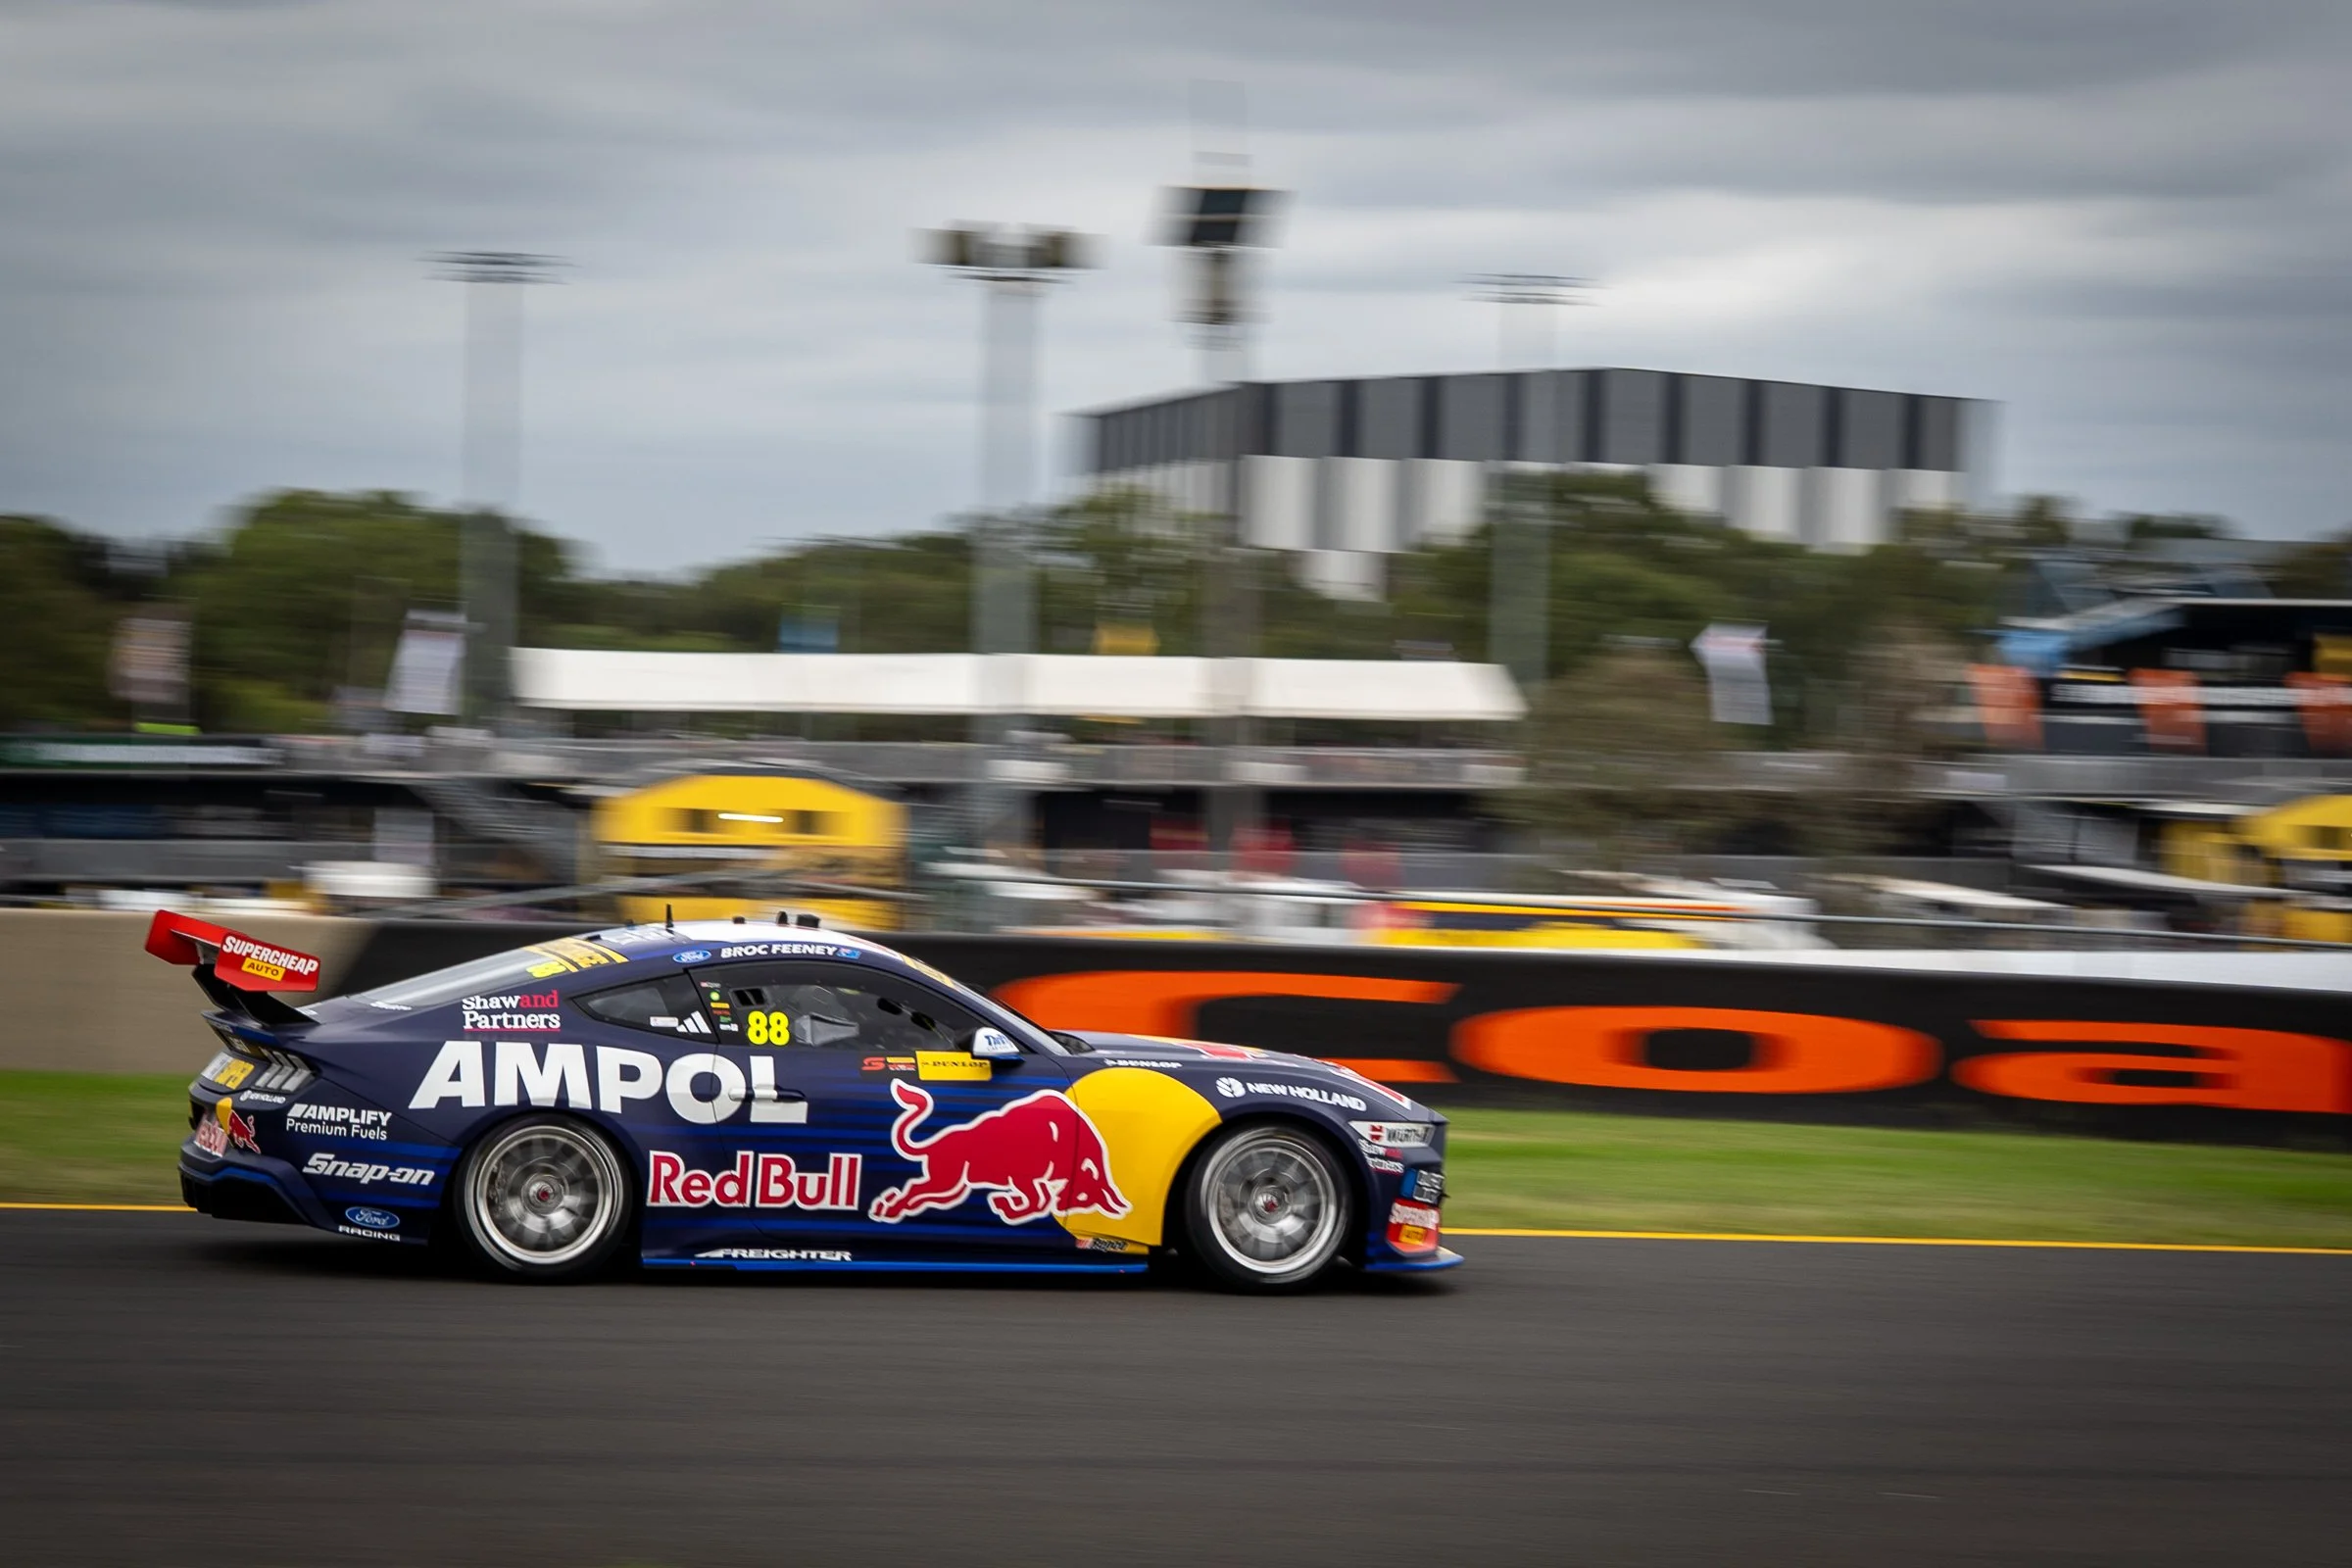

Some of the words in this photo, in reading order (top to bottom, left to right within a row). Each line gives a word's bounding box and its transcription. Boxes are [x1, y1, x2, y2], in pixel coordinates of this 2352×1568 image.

[222, 936, 318, 976] SUPERCHEAP
[720, 944, 768, 958] BROC
[771, 943, 838, 956] FEENEY
[247, 962, 279, 977] AUTO
[463, 1010, 562, 1030] Partners
[747, 1010, 790, 1046] 88
[931, 1059, 989, 1069] DUNLOP
[1116, 1058, 1183, 1069] DUNLOP
[408, 1040, 808, 1125] AMPOL
[1248, 1081, 1288, 1098] NEW
[1288, 1086, 1367, 1112] HOLLAND
[303, 1104, 392, 1126] AMPLIFY
[286, 1117, 347, 1137] Premium
[351, 1124, 388, 1141] Fuels
[302, 1152, 435, 1186] Snap-on
[647, 1151, 754, 1208] Red
[756, 1153, 862, 1210] Bull
[355, 1207, 390, 1226] Ford
[338, 1225, 401, 1242] RACING
[720, 1249, 853, 1262] FREIGHTER
